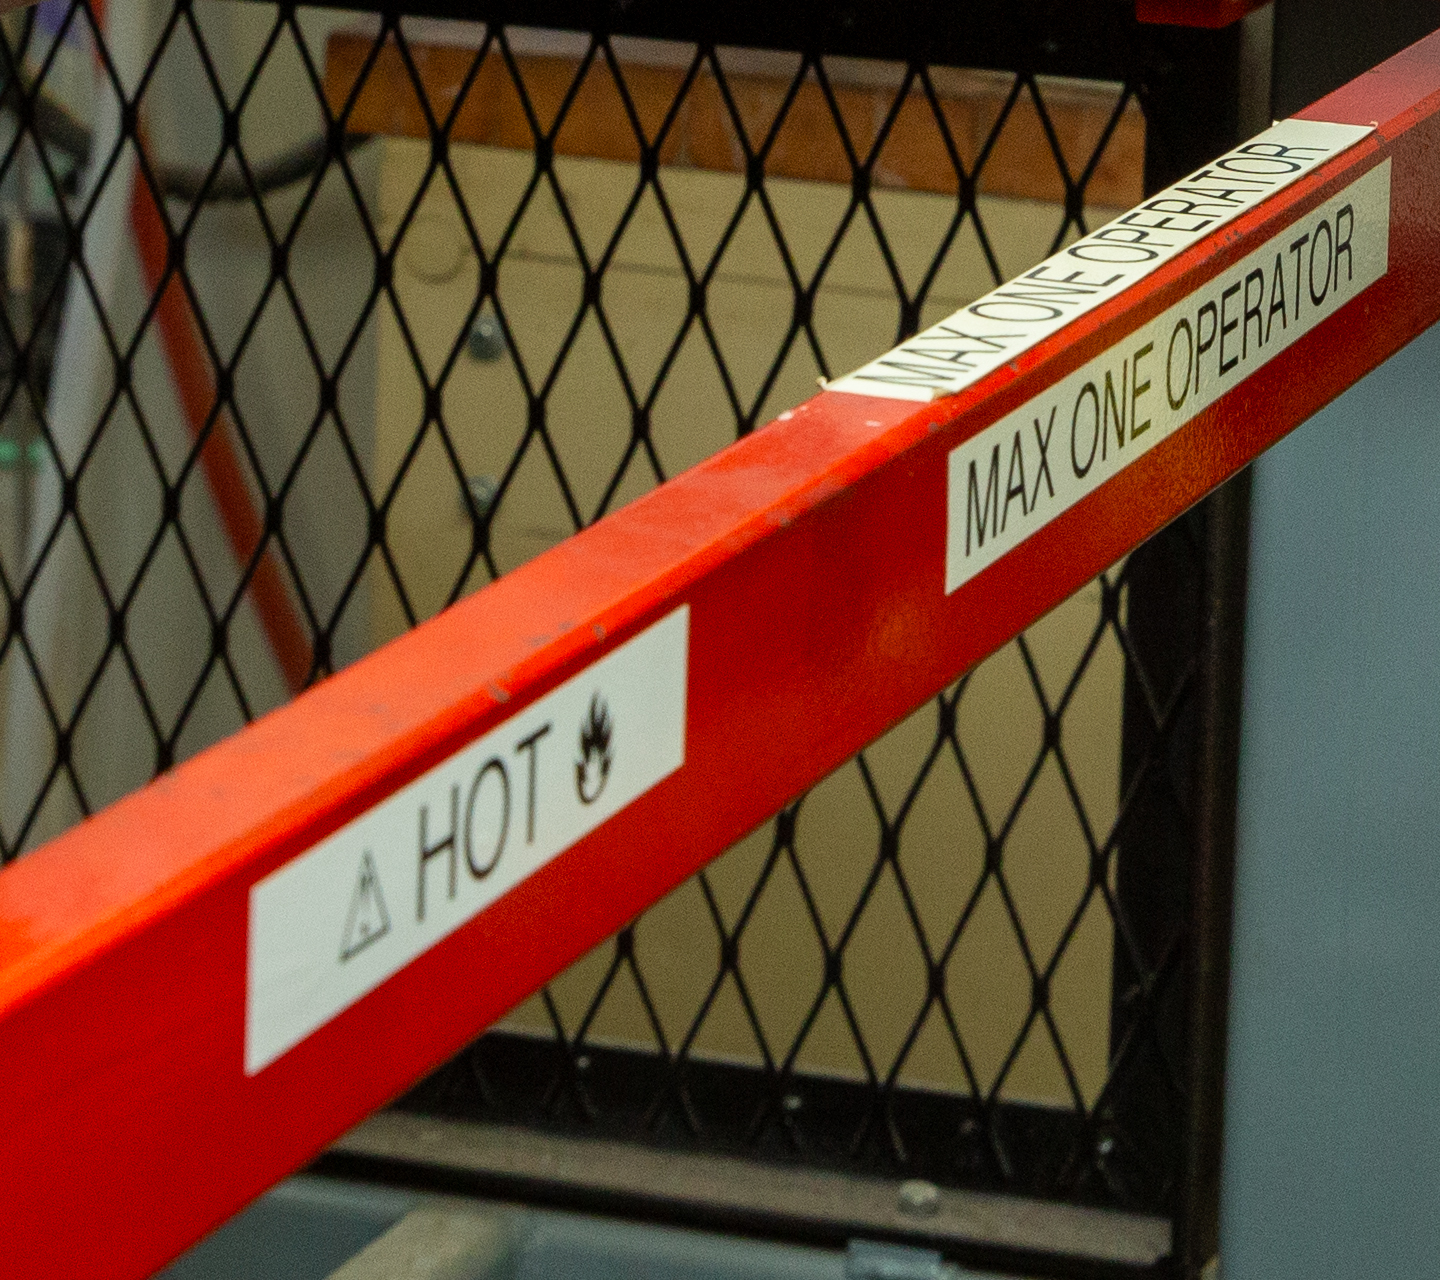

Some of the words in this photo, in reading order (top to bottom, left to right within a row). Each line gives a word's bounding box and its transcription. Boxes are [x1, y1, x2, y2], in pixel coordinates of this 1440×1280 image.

[855, 326, 1029, 388] MAX
[969, 266, 1124, 324] ONE
[1067, 141, 1331, 264] OPERATOR
[965, 405, 1058, 557] MAX
[1070, 341, 1155, 480] ONE
[1166, 203, 1355, 411] OPERATOR
[414, 720, 554, 923] HOT
